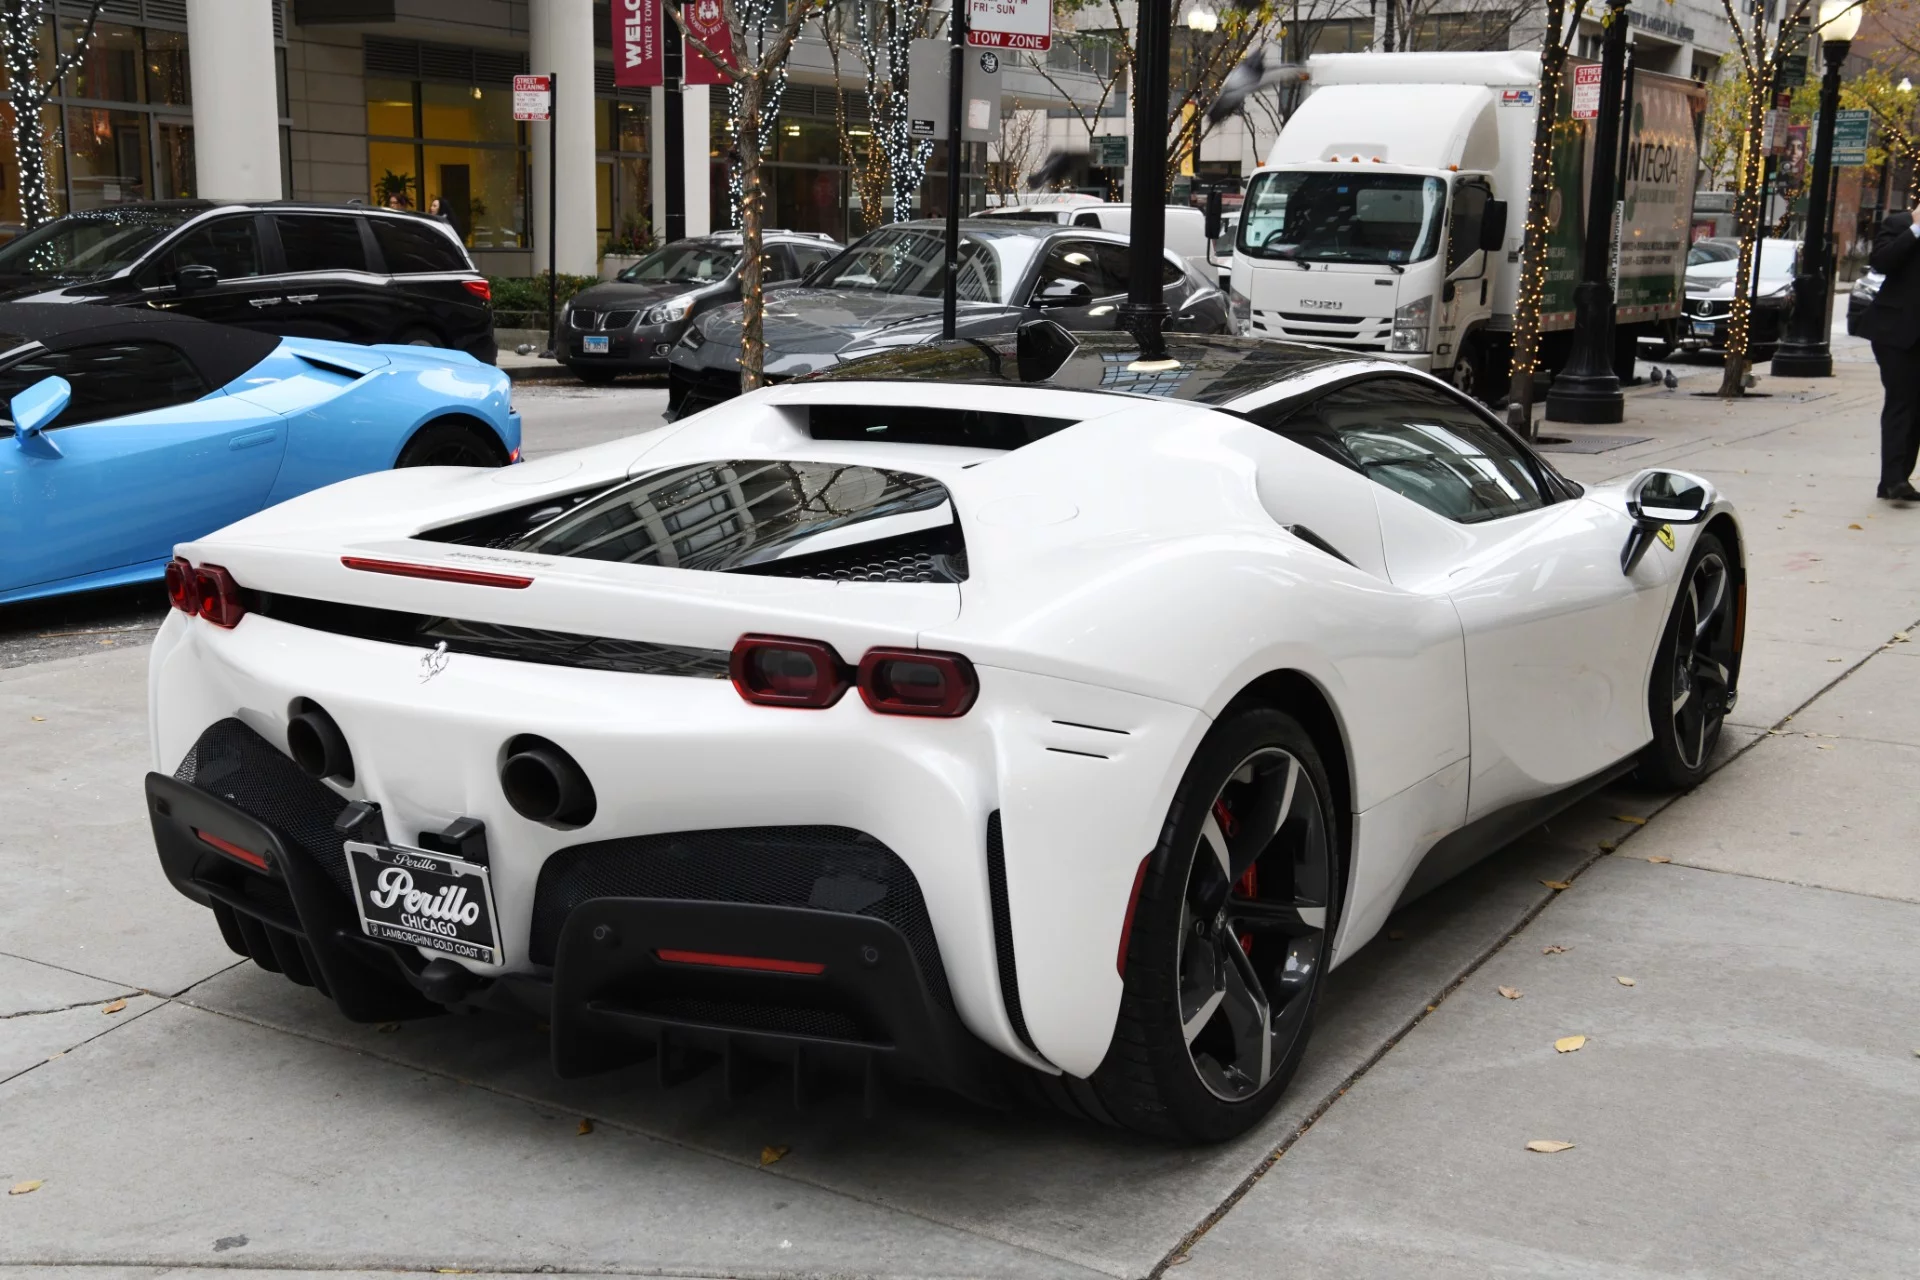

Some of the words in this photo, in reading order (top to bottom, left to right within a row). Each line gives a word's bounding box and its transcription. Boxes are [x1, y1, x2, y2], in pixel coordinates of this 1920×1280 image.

[973, 2, 988, 12] FRI
[996, 4, 1015, 14] SUN
[644, 26, 652, 60] WATER
[973, 31, 1001, 45] TOW
[1008, 34, 1043, 48] ZONE
[1627, 142, 1678, 184] NTEGRA
[1300, 299, 1342, 309] ISUZU
[393, 853, 437, 871] Perillo
[370, 867, 479, 926] Perillo
[401, 913, 457, 937] CHICAGO
[382, 927, 432, 947] LAMBORGHINI
[433, 940, 453, 951] GOLD
[455, 944, 478, 957] COAST
